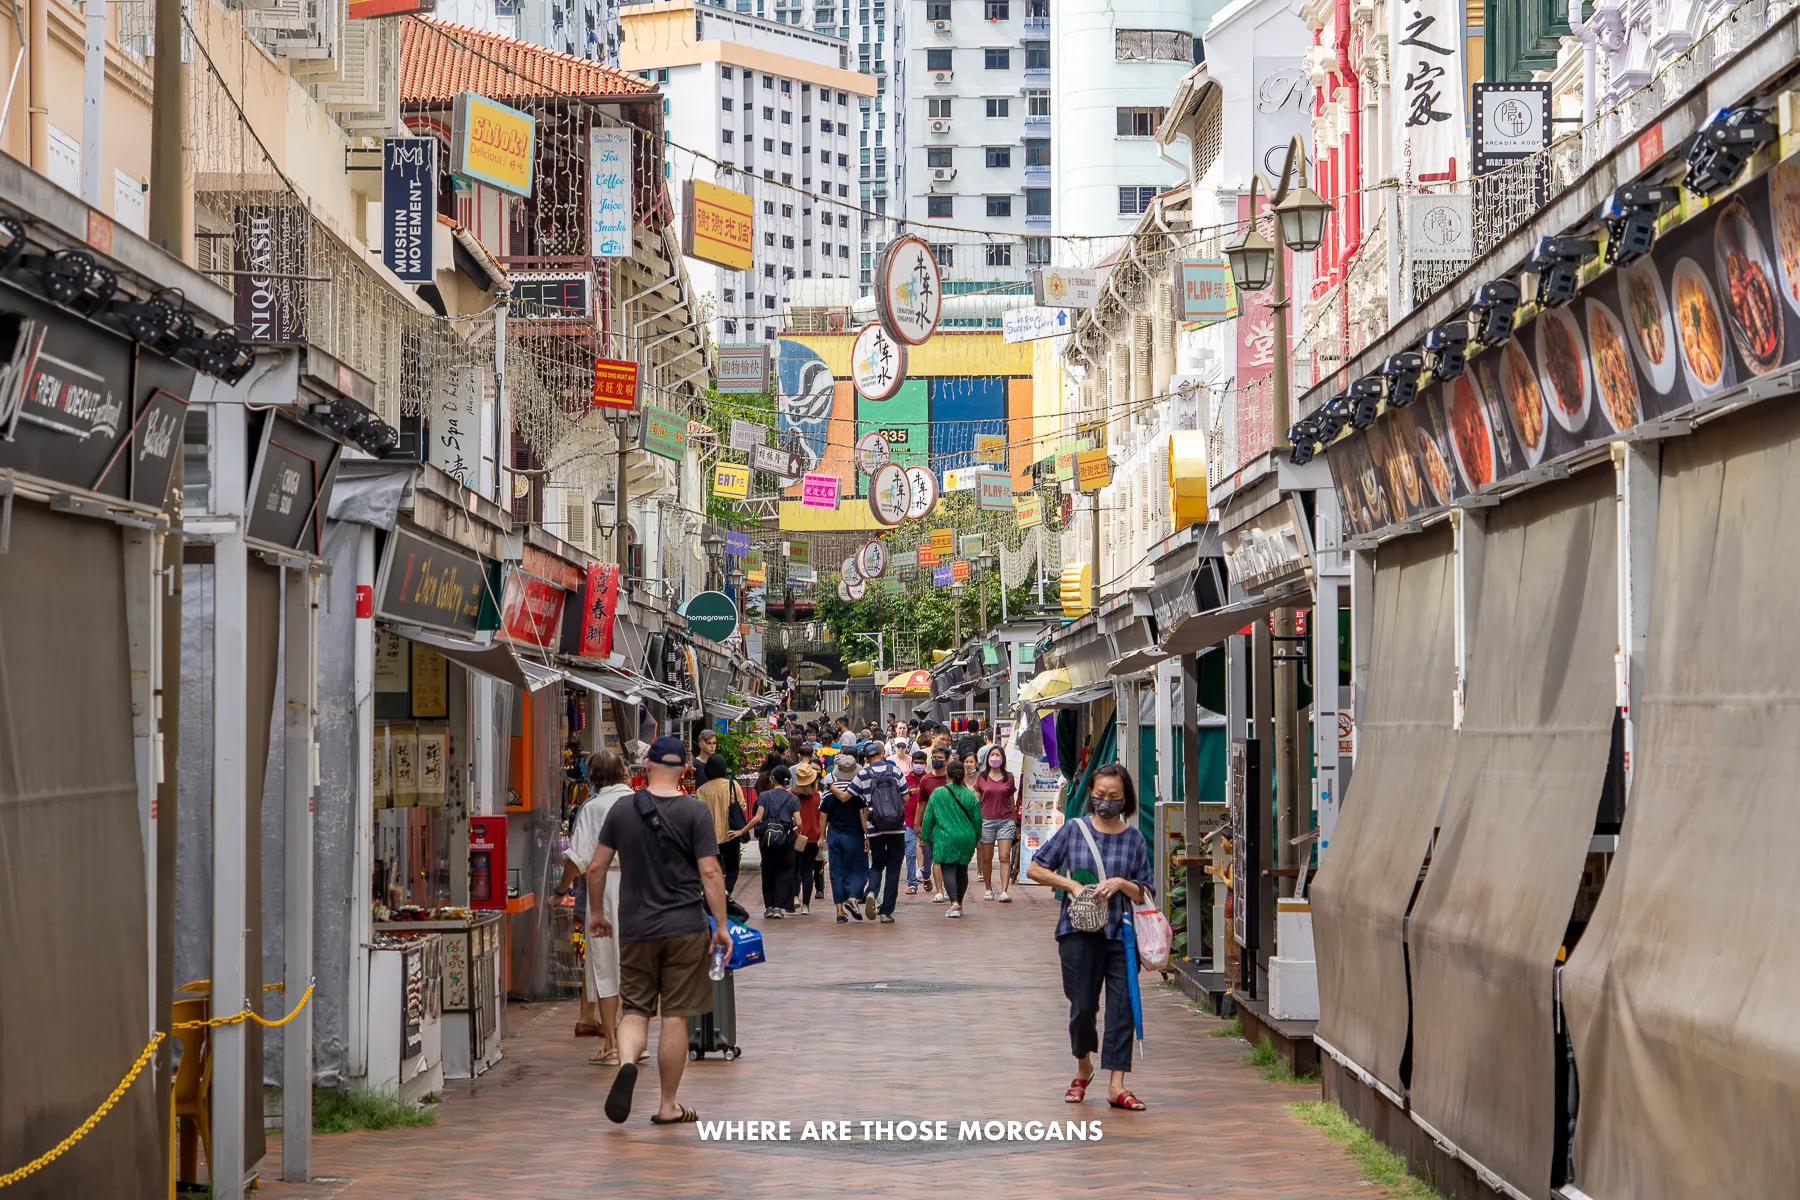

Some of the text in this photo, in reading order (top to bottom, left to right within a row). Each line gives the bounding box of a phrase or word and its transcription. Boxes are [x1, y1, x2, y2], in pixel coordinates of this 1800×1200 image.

[472, 116, 528, 159] Shiok!
[601, 150, 619, 162] Tea
[595, 173, 625, 189] Coffee
[598, 199, 623, 214] Juice
[409, 180, 422, 273] MOVEMENT
[594, 220, 627, 233] Snacks
[697, 208, 750, 243] 谢谢光临
[395, 209, 407, 273] MUSHIN
[914, 250, 933, 331] 牛车水
[1187, 281, 1223, 299] PLAY 玩
[896, 308, 915, 316] CHINATOWN
[896, 315, 915, 323] SINGAPORE
[874, 329, 892, 387] 牛车水
[721, 360, 759, 375] 购物愉快
[595, 381, 634, 396] 兴旺发啊
[441, 419, 464, 451] Spa
[717, 473, 736, 487] EAT
[893, 470, 905, 516] 牛车水
[914, 472, 927, 509] 牛车水
[984, 485, 1002, 497] PLAY
[1018, 509, 1033, 520] SHOP
[585, 572, 609, 644] 寫春聯
[687, 614, 729, 622] homegrown
